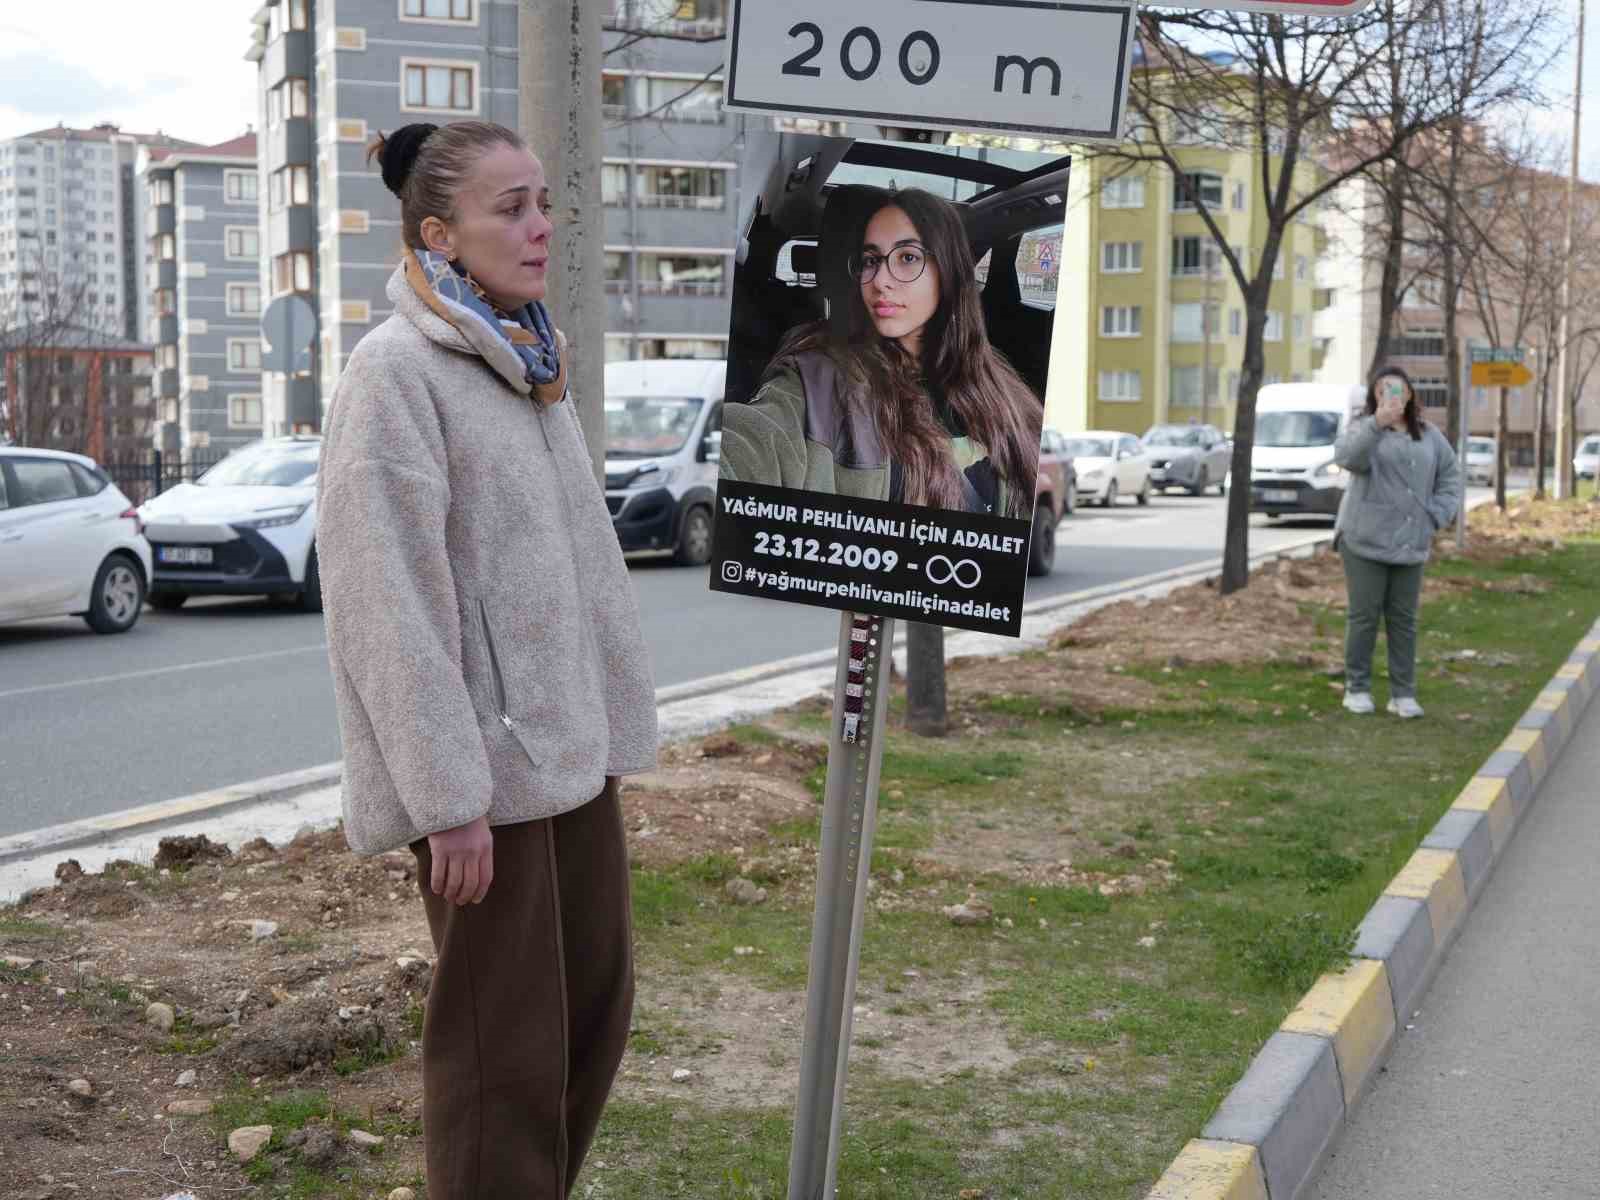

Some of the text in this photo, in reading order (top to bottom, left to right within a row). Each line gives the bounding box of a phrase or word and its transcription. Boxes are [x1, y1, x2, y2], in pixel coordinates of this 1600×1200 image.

[781, 21, 1062, 97] 200 m
[722, 496, 1025, 554] YAĞMUR PEHLİVANLI İÇİN ADALET
[753, 531, 899, 573] 23.12.2009
[744, 567, 1011, 623] #yağmurpehlivanliiçinadalet
